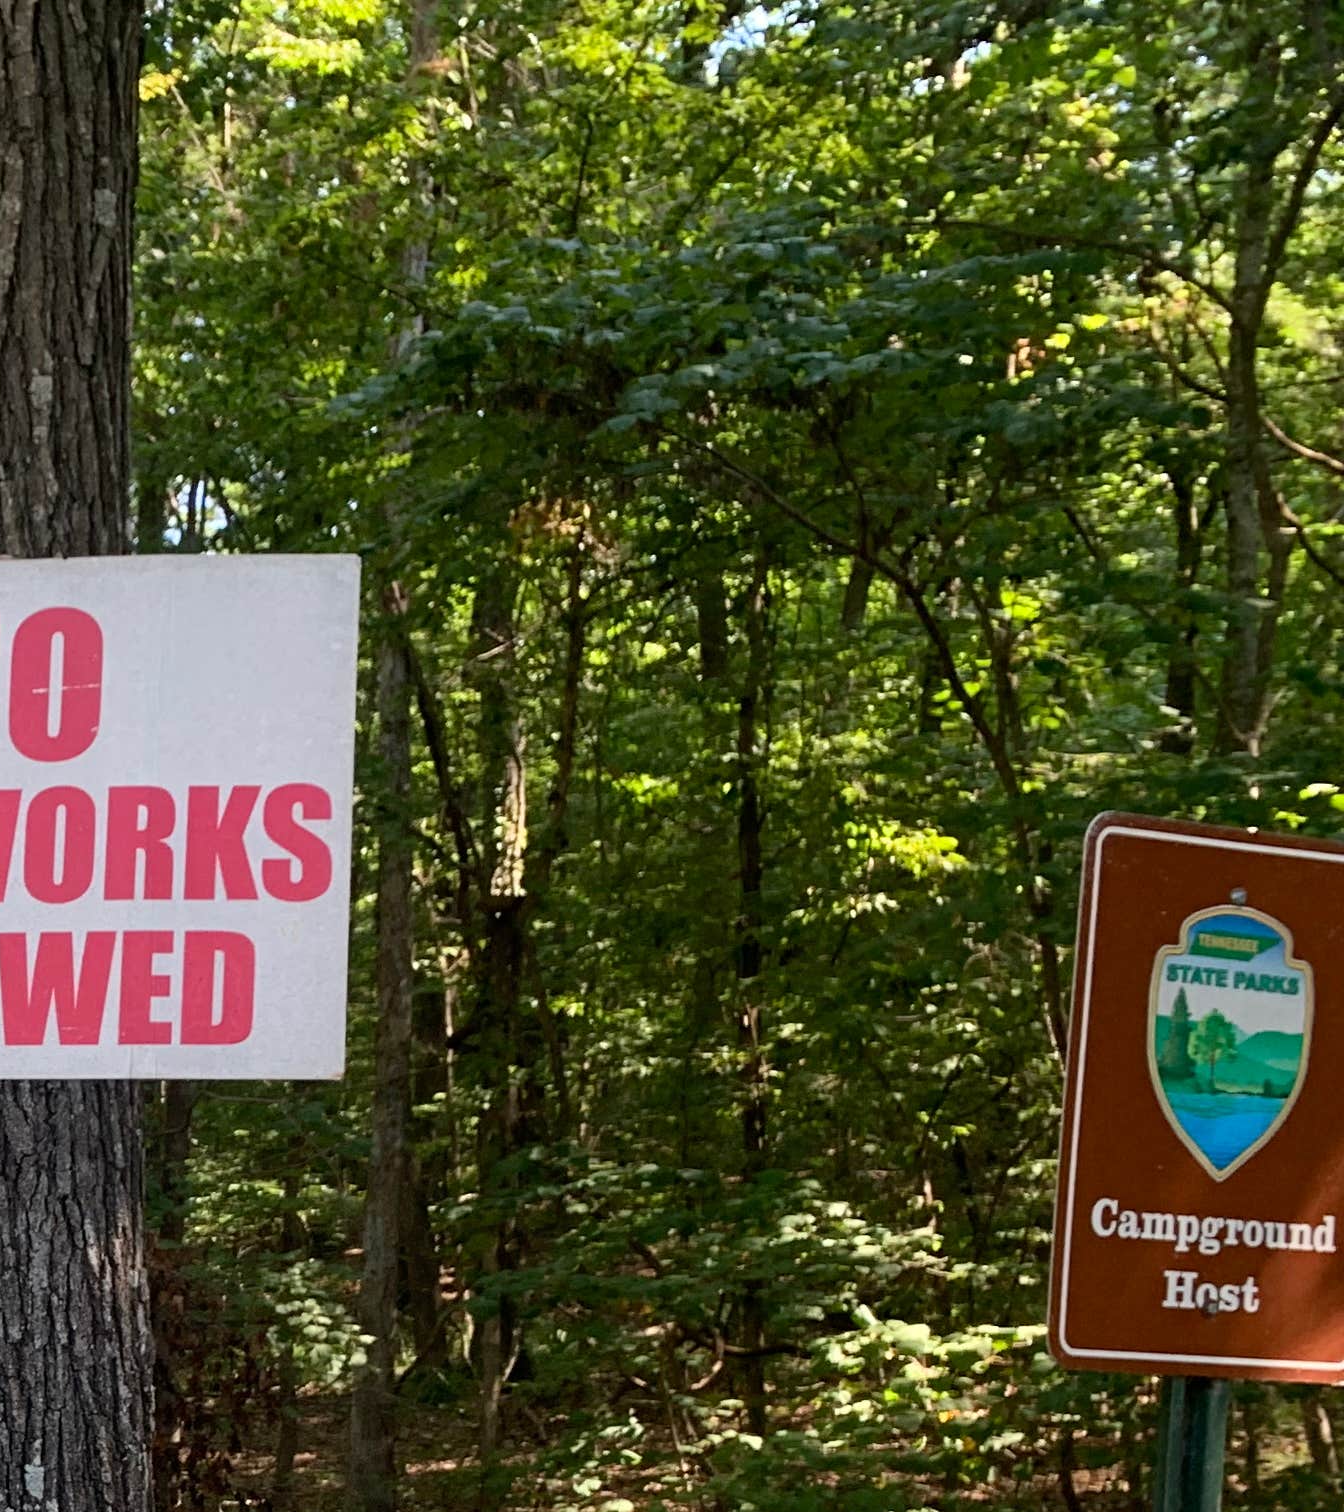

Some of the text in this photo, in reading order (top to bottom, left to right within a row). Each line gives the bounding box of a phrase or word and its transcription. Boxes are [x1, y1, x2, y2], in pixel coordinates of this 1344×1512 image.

[1166, 964, 1299, 996] STATE PARKS
[1091, 1198, 1336, 1255] Campground
[1162, 1270, 1260, 1313] Host
